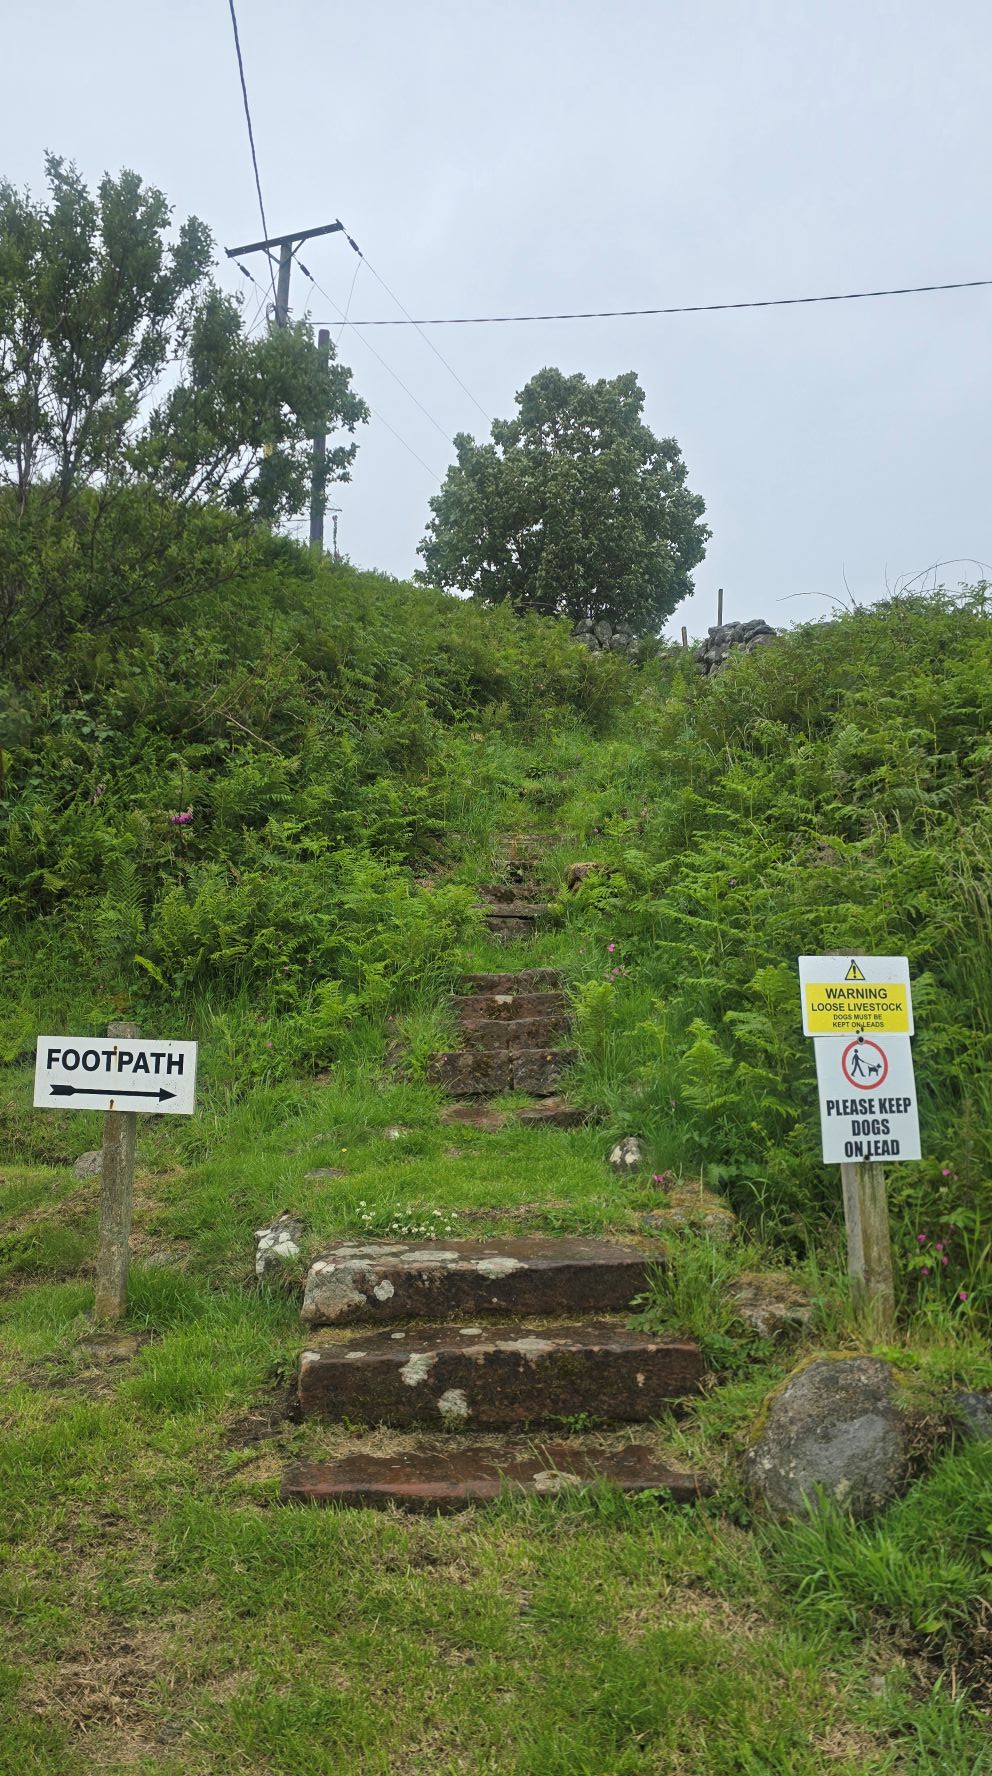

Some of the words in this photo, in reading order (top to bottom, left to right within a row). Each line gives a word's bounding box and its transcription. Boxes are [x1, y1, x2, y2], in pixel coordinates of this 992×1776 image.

[825, 988, 888, 999] WARNING
[811, 1002, 845, 1011] LOOSE
[848, 1002, 903, 1011] LIVESTOCK
[46, 1048, 185, 1076] FOOTPATH
[826, 1098, 876, 1116] PLEASE
[878, 1097, 912, 1115] KEEP
[851, 1118, 890, 1136] DOGS
[844, 1140, 864, 1158] ON
[867, 1139, 900, 1157] LEAD
